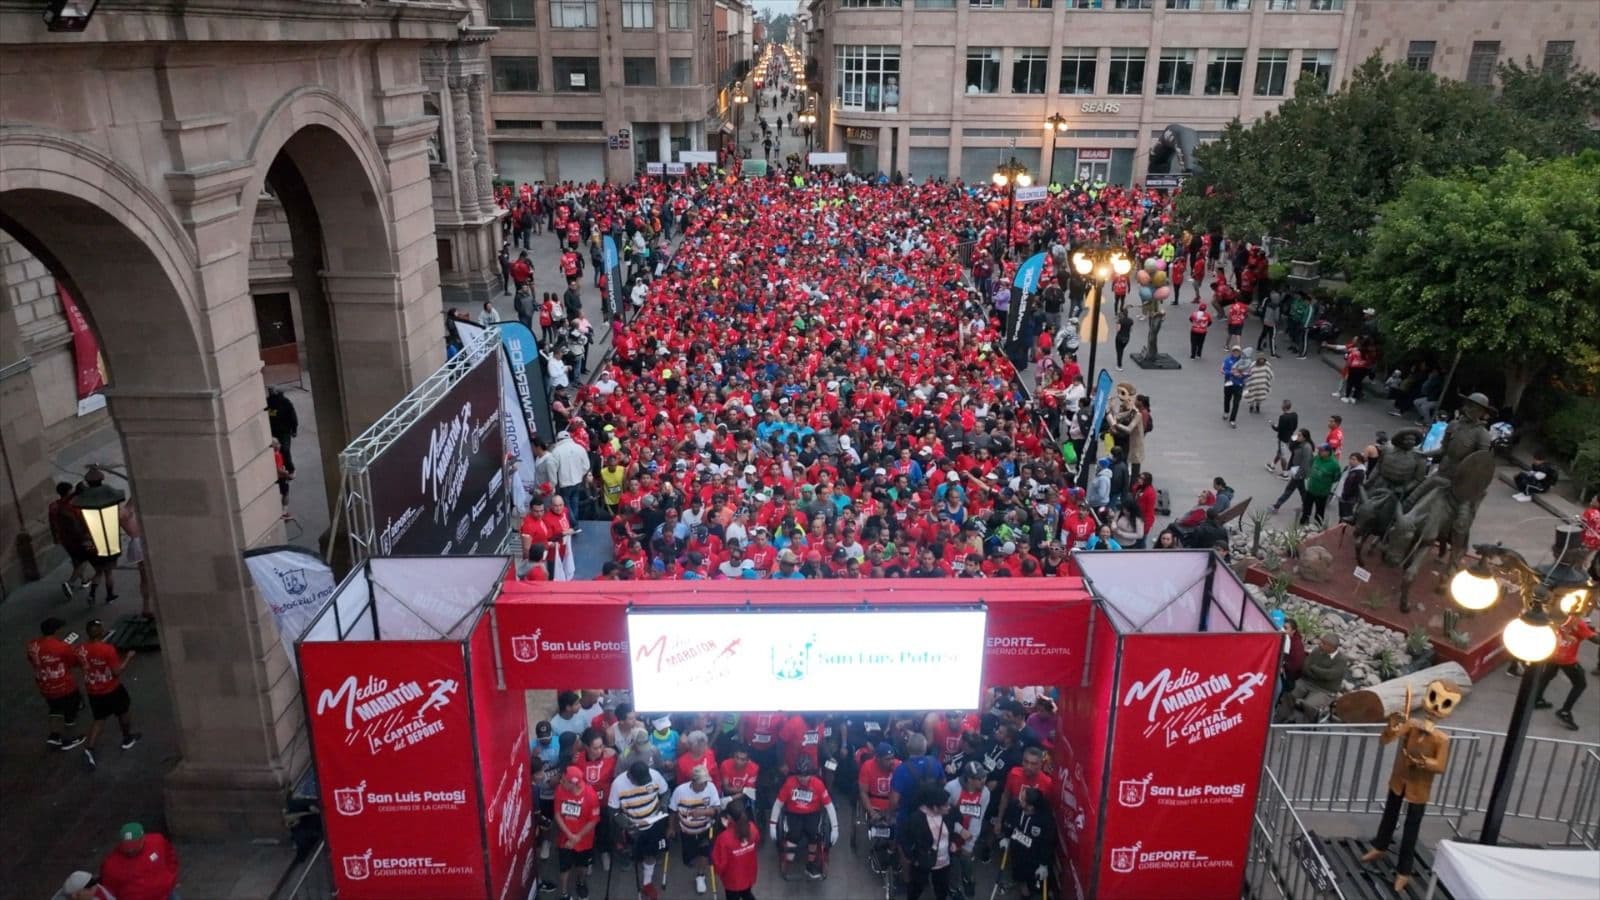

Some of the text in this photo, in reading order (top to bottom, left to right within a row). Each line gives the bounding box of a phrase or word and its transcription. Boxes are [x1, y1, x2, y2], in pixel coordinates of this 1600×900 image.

[1081, 102, 1120, 113] SEARS
[1081, 150, 1109, 159] SEARS
[542, 640, 628, 653] San Luis PotoS
[985, 637, 1034, 647] EPORTE
[1041, 647, 1071, 655] CAPITAL
[1123, 668, 1200, 722] Medio
[1161, 673, 1232, 714] MARATÓN
[317, 675, 388, 730] Medio
[355, 681, 424, 722] MARATÓN
[1166, 711, 1227, 748] LA CAPITAL
[1203, 712, 1243, 739] DEPORTE
[368, 718, 427, 755] LA CAPITAL
[406, 719, 445, 745] DEPORTE
[367, 793, 392, 803] San
[395, 791, 421, 802] Luis
[1150, 785, 1174, 796] San
[1177, 786, 1201, 797] Luis
[1140, 850, 1197, 862] DEPORTE
[373, 858, 433, 869] DEPORTE
[1138, 860, 1178, 869] GOBIERNO
[1181, 860, 1190, 868] DE
[1203, 859, 1233, 867] CAPITAL
[374, 868, 417, 877] GOBIERNO
[431, 867, 441, 875] LA
[442, 866, 473, 874] CAPITAL
